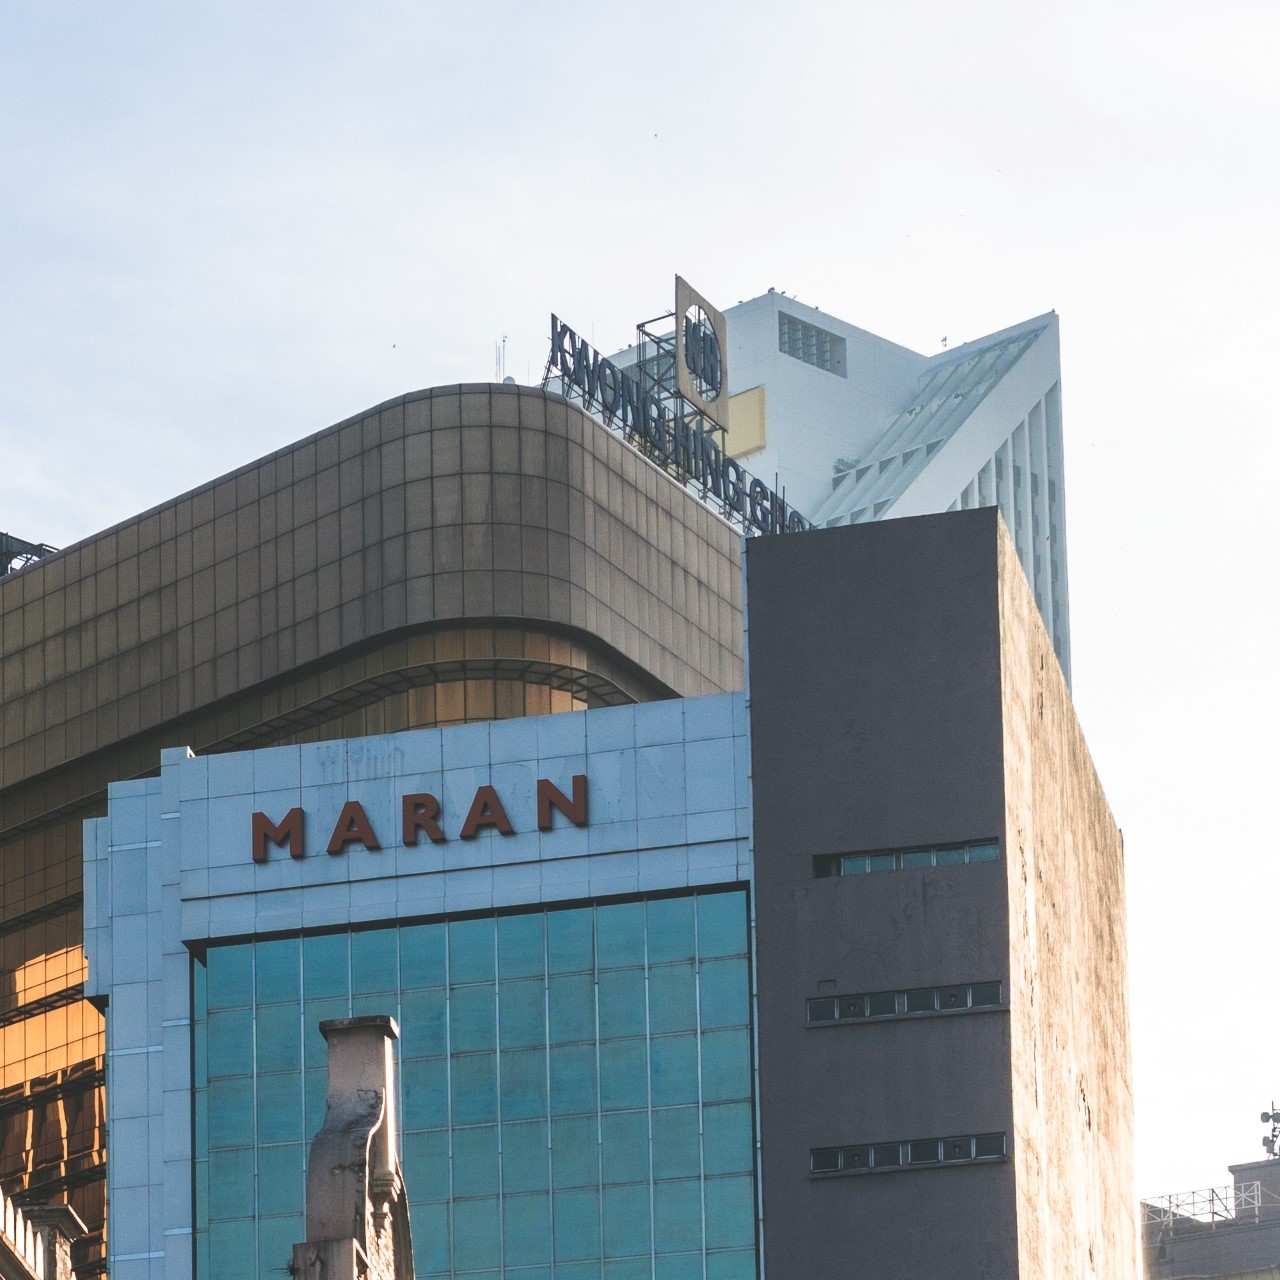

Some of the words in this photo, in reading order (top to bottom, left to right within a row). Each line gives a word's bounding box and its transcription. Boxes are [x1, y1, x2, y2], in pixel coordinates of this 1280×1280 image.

[551, 313, 667, 453] KWONG
[674, 412, 743, 511] HING
[252, 774, 589, 863] MARAN
